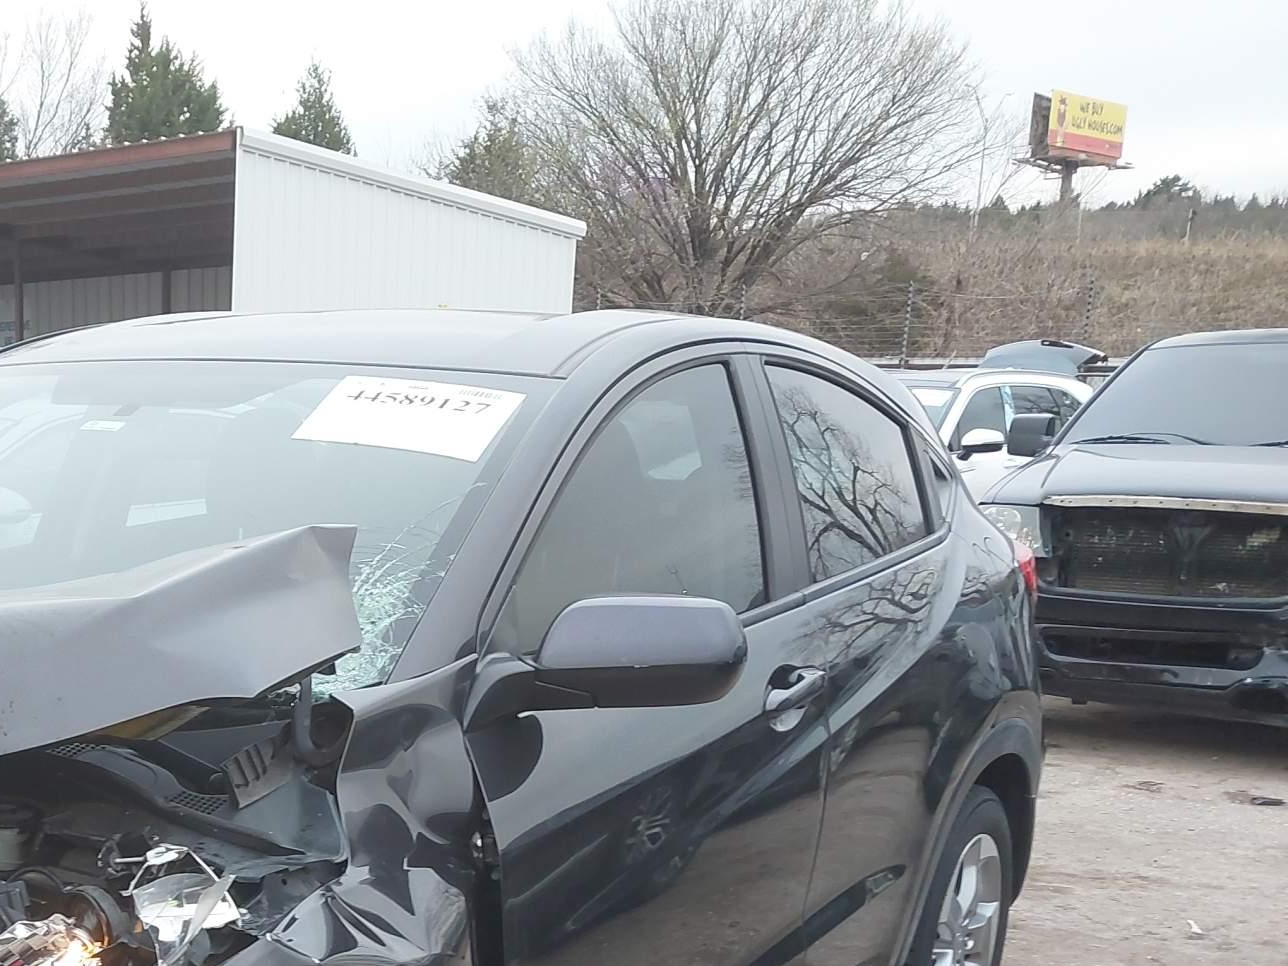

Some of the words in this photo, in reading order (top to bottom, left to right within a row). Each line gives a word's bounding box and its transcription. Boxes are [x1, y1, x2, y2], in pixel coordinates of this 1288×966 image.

[1079, 102, 1090, 113] WE
[1091, 102, 1104, 116] BUY
[346, 389, 492, 415] 44589127
